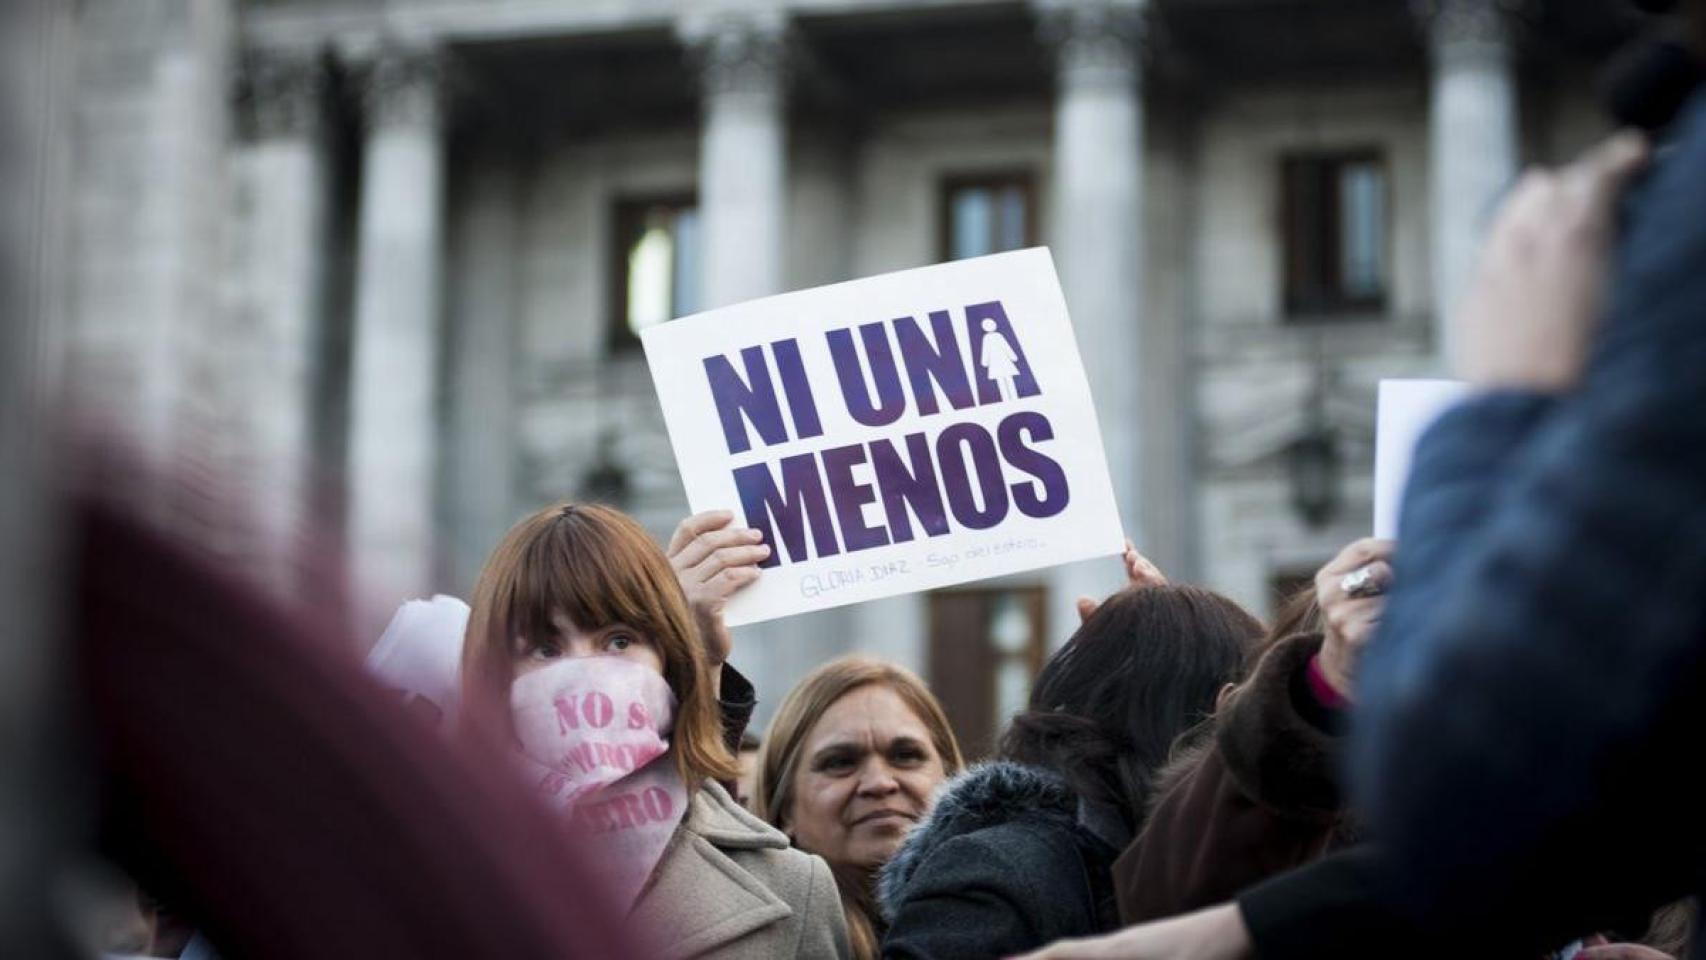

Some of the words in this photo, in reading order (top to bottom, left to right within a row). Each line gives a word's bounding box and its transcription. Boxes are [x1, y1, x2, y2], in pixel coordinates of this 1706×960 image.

[703, 337, 824, 455] NI
[825, 300, 1042, 427] UNA
[732, 411, 1071, 569] MENOS
[800, 572, 864, 599] GLORIA
[870, 559, 911, 583] DIAZ
[553, 691, 614, 737] NO
